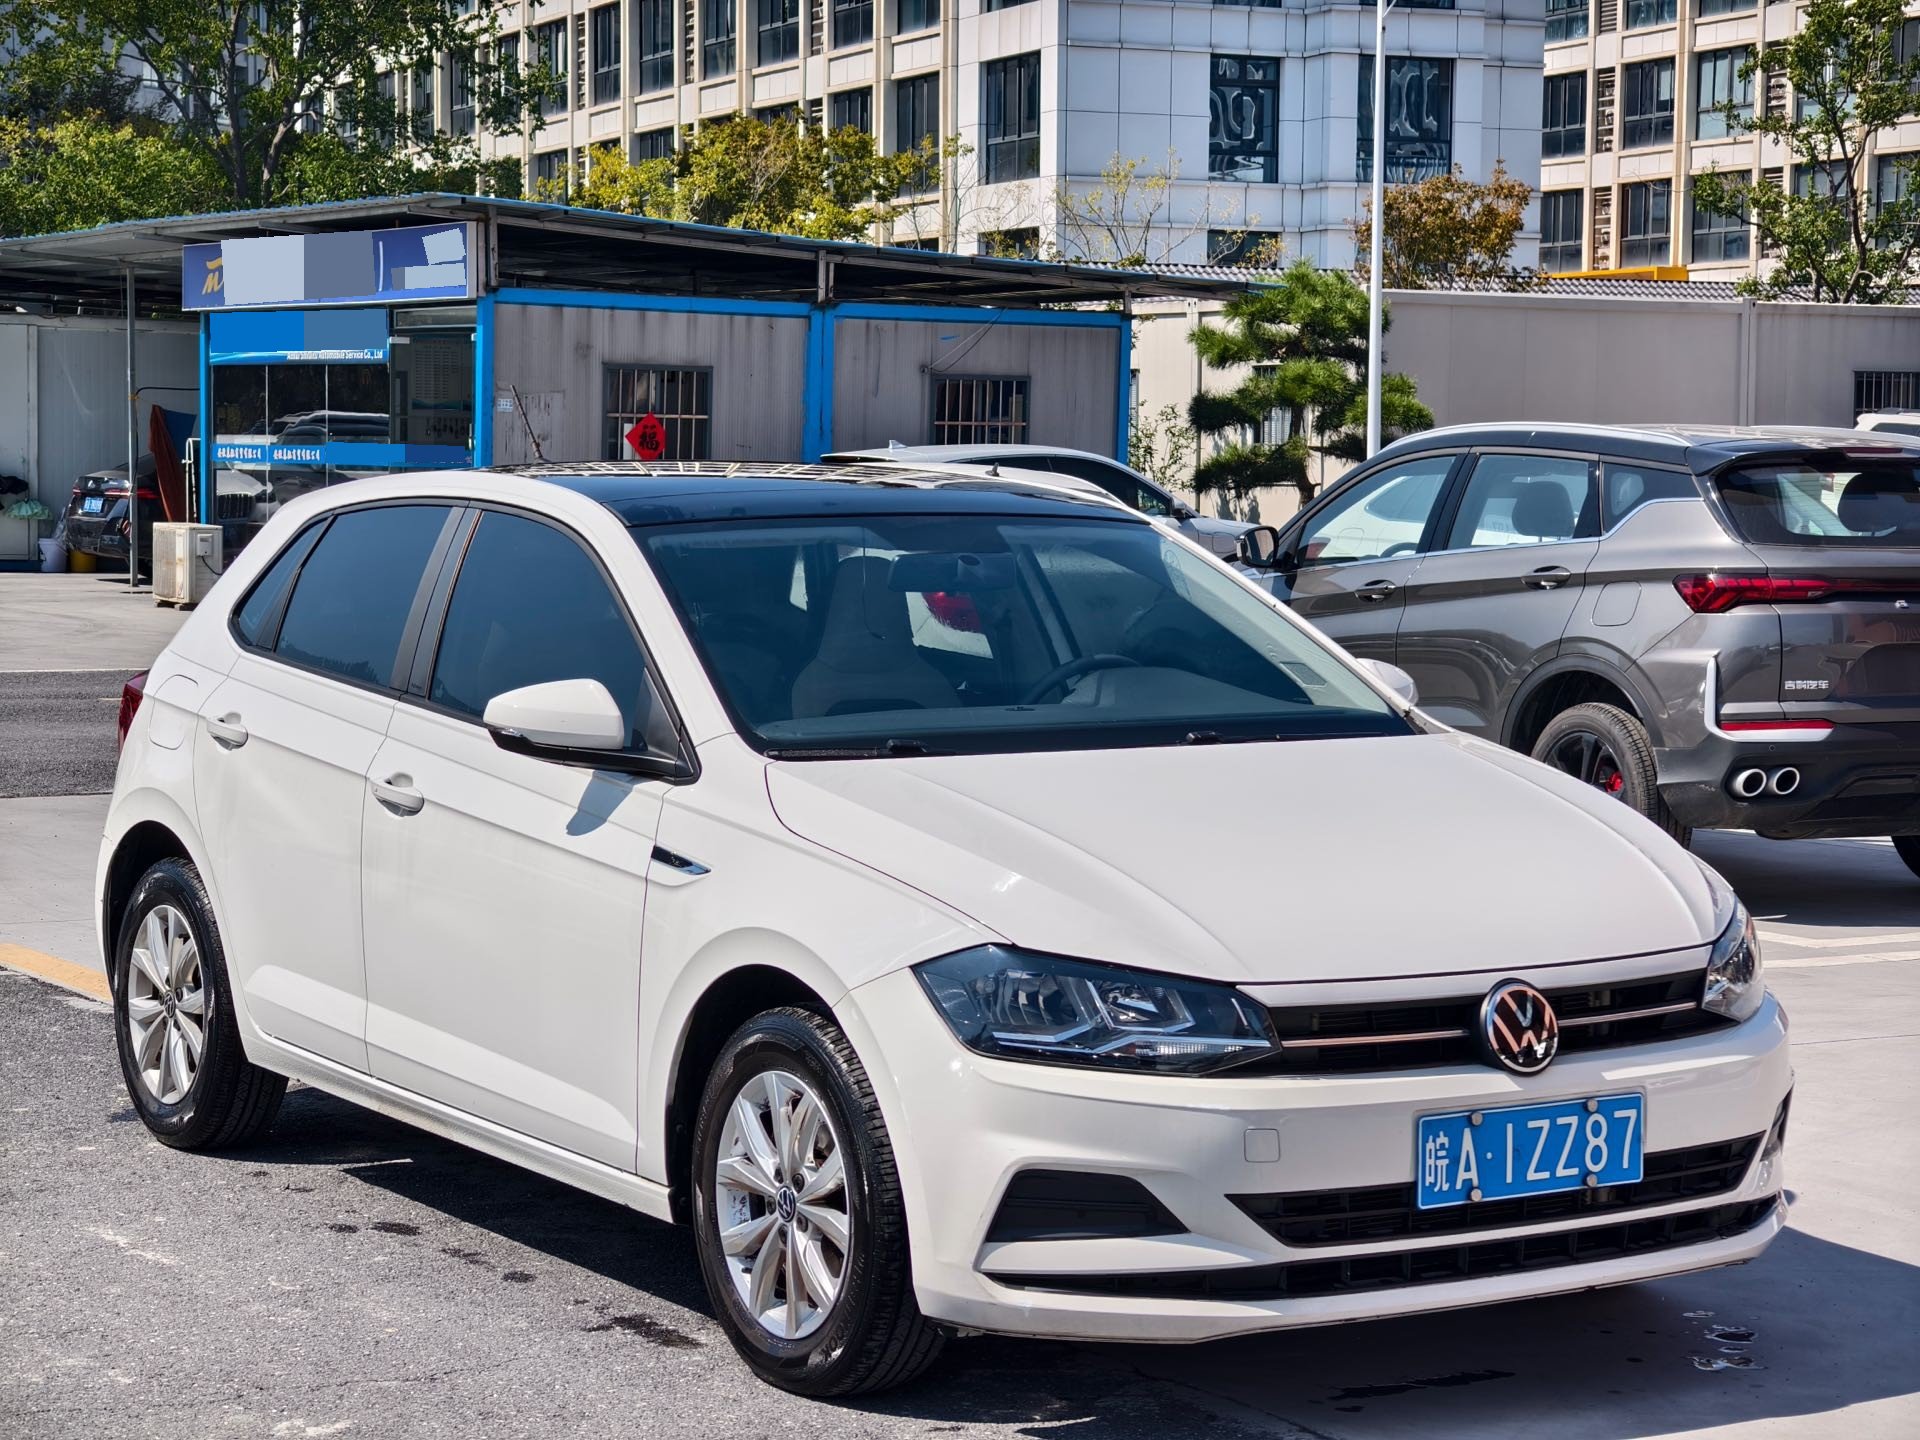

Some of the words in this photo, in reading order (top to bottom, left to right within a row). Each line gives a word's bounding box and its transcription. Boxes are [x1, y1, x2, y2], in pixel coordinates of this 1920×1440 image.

[346, 350, 364, 360] Service
[374, 349, 383, 359] Ltd
[1784, 679, 1829, 690] 吉利汽车
[1425, 1108, 1638, 1193] 皖A·1ZZ87
